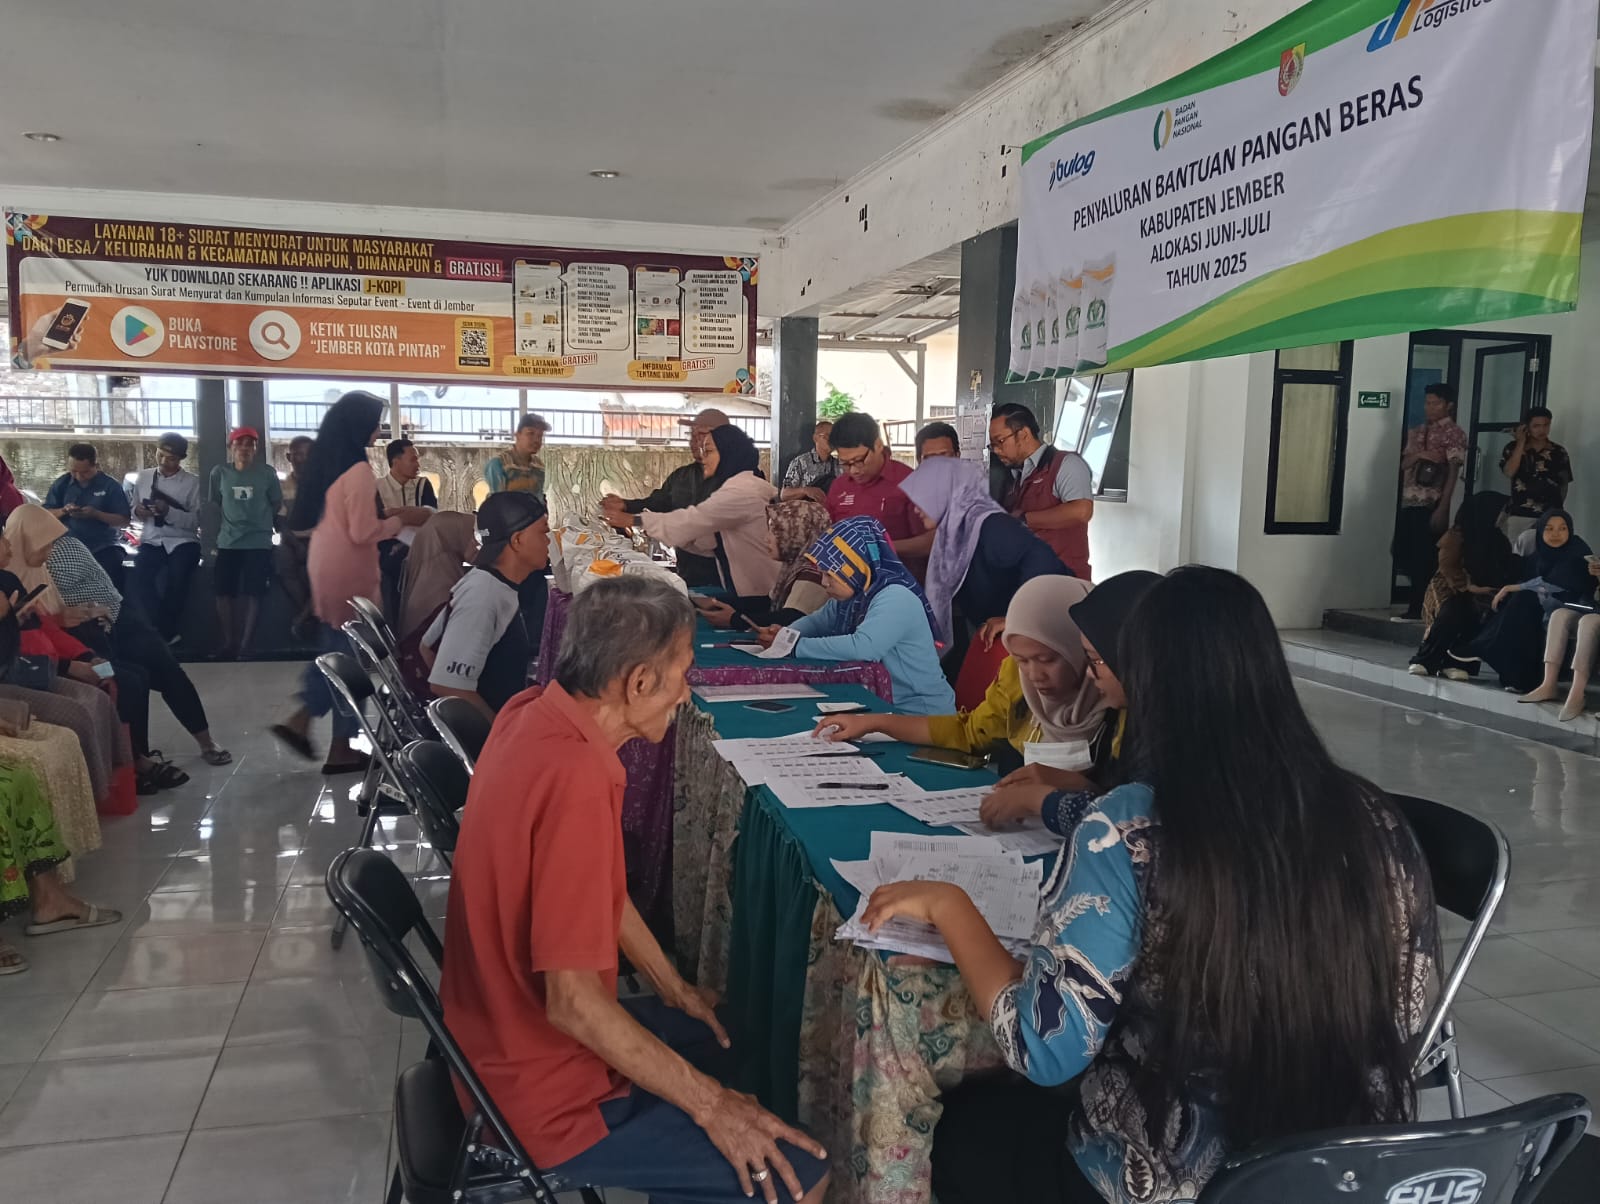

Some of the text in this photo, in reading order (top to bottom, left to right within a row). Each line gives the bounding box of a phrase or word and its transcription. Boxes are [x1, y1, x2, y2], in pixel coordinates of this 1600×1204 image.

[1413, 0, 1493, 32] Logistic
[1173, 110, 1199, 128] PANGAN
[1175, 100, 1196, 117] BADAN
[1172, 119, 1203, 139] NASIONAL
[1055, 150, 1096, 182] bulog
[1073, 74, 1424, 232] PENYALURAN BANTUAN PANGAN BERAS
[1140, 171, 1285, 239] KABUPATEN JEMBER
[95, 223, 435, 258] LAYANAN 18+ SURAT MENYURAT UNTUK MASYARAKAT
[1150, 210, 1272, 264] ALOKASI JUNI-JULI
[105, 240, 183, 260] KELURAHAN
[187, 245, 196, 260] &
[200, 245, 278, 265] KECAMATAN
[281, 251, 353, 271] KAPANPUN,
[357, 255, 430, 273] DIMANAPUN
[434, 259, 442, 274] &
[449, 260, 501, 277] GRATIS!!
[1166, 252, 1247, 290] TAHUN 2025
[144, 267, 168, 282] YUK
[171, 269, 235, 286] DOWNLOAD
[238, 272, 297, 289] SEKARANG
[311, 276, 361, 292] APLIKASI
[366, 279, 402, 294] J-KOPI
[65, 280, 112, 293] Permudah
[115, 284, 148, 296] Urusan
[151, 285, 176, 297] Surat
[179, 286, 222, 301] Menyurat
[225, 288, 242, 300] dan
[245, 290, 289, 304] Kumpulan
[292, 292, 335, 305] Informasi
[337, 294, 371, 308] Seputar
[374, 296, 398, 309] Event
[407, 298, 430, 311] Event
[433, 299, 442, 310] di
[444, 301, 475, 312] Jember
[169, 317, 202, 332] BUKA
[310, 322, 398, 340] KETIK TULISAN
[169, 334, 237, 351] PLAYSTORE
[365, 341, 395, 357] KOTA
[642, 362, 672, 371] INFORMASI
[446, 661, 475, 678] JCC
